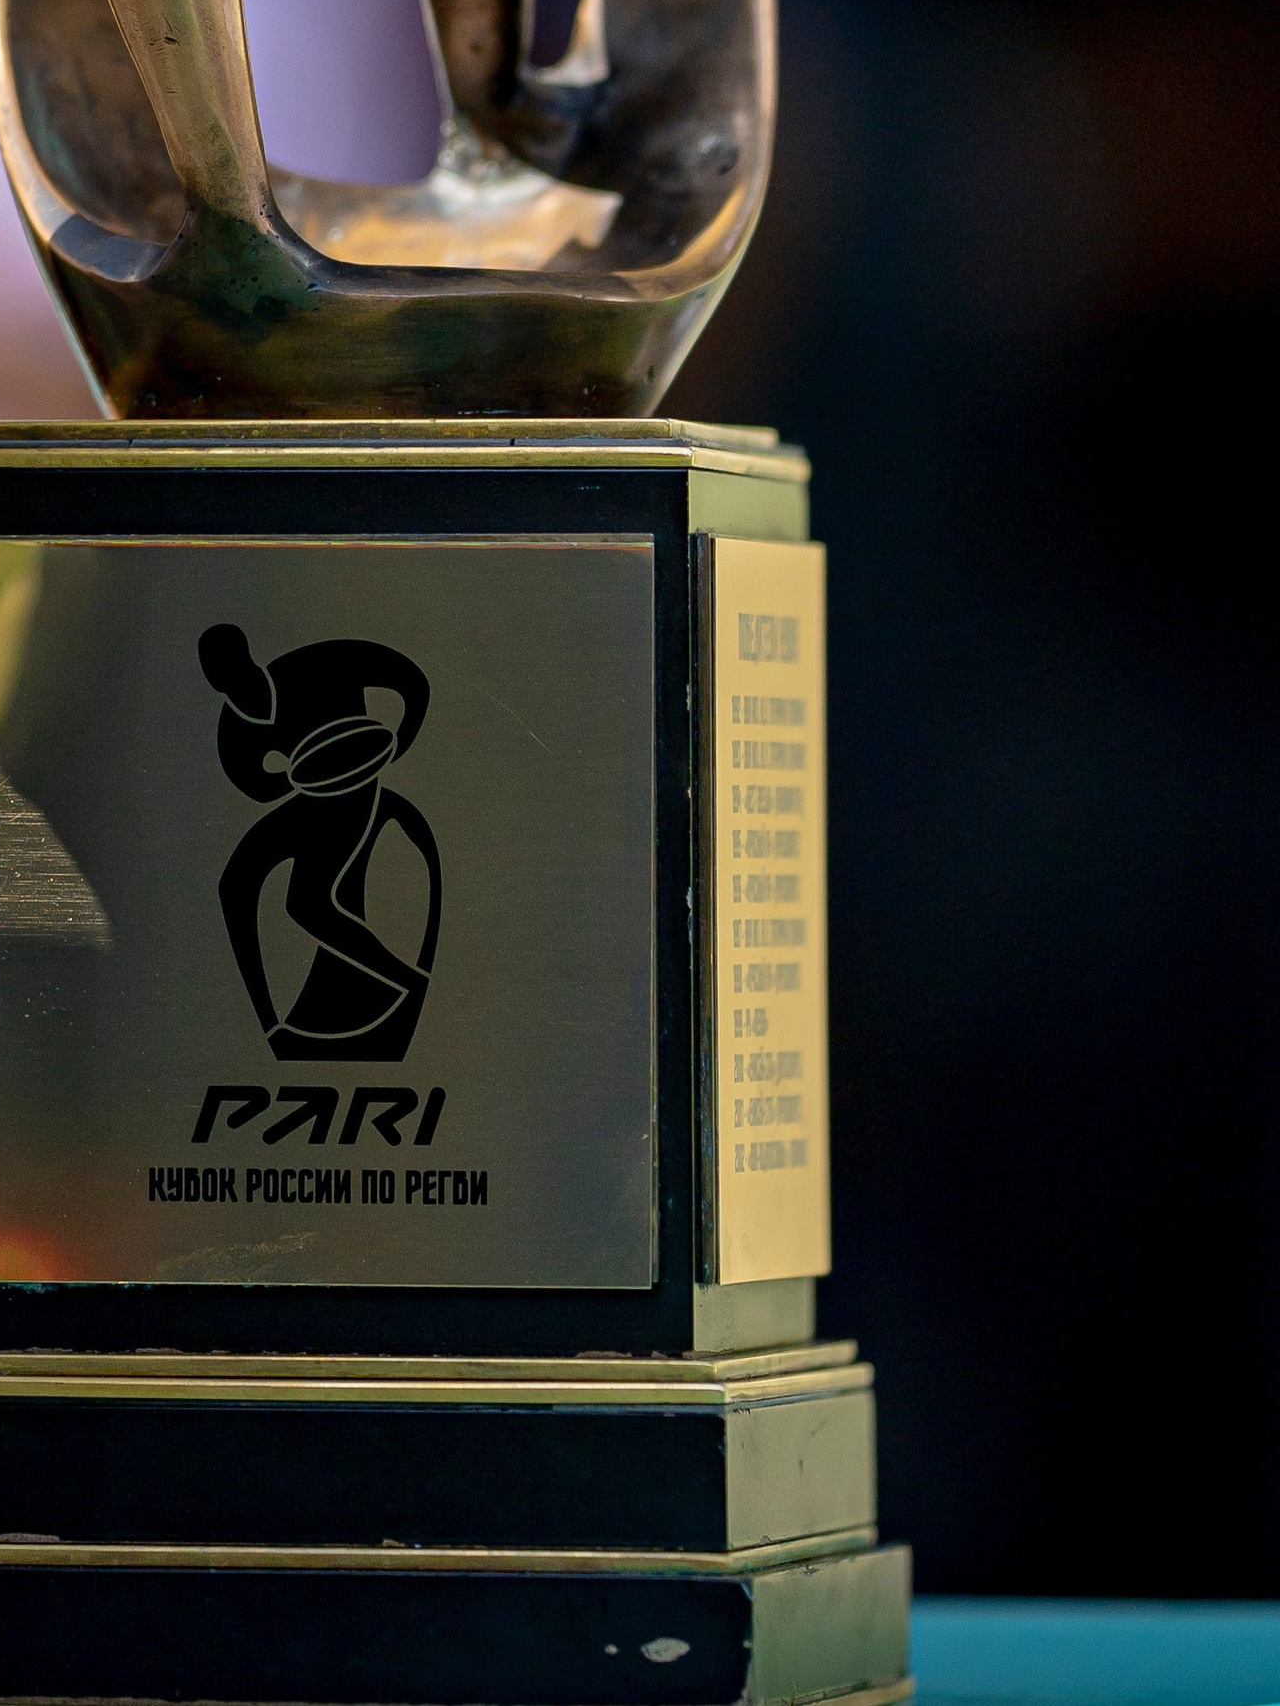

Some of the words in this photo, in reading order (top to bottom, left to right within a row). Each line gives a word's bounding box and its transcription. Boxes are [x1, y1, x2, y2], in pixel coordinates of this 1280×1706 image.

[190, 1084, 447, 1146] PARI
[148, 1167, 239, 1203] КУБОК
[245, 1168, 352, 1204] РОССИИ
[361, 1169, 396, 1205] ПО
[405, 1170, 488, 1206] РЕГБИ
